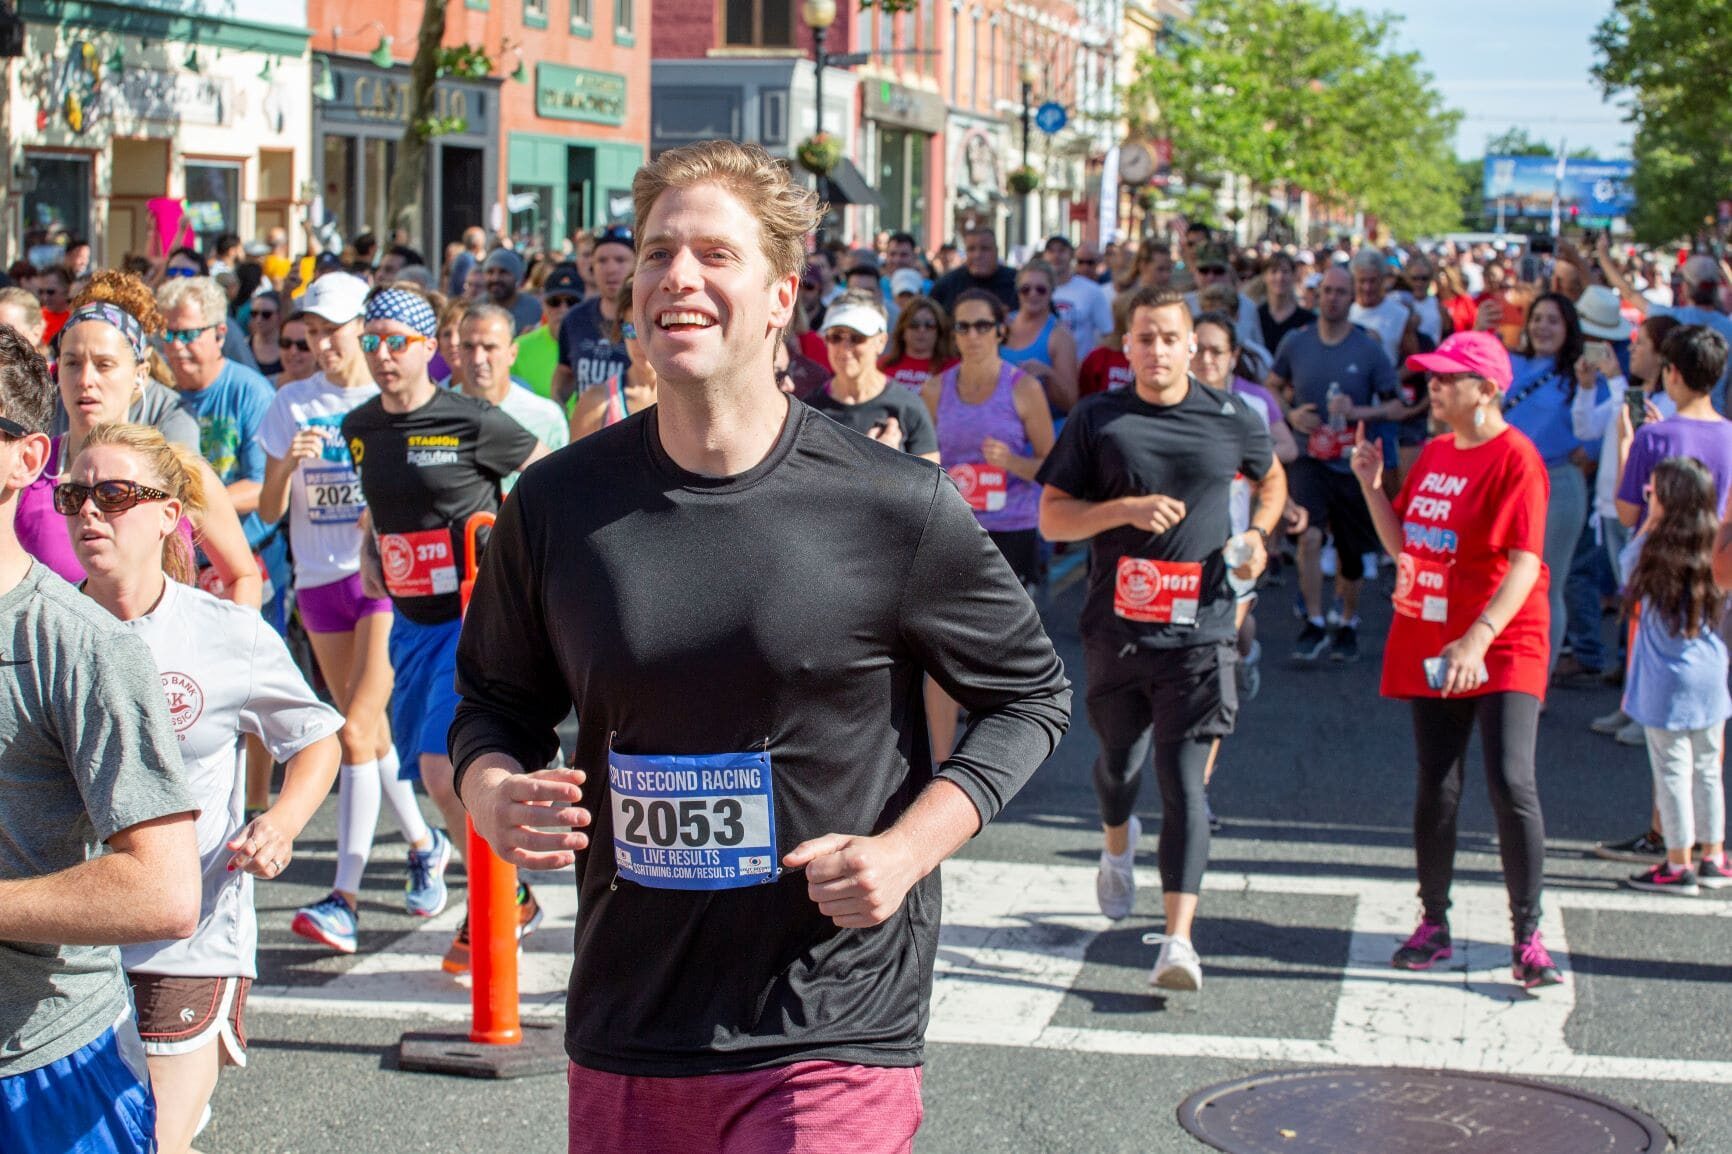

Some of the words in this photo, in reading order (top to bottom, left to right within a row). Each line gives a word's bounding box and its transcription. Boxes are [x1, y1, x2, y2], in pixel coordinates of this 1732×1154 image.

[577, 358, 624, 384] RUN
[407, 435, 459, 447] STADION
[406, 450, 458, 463] Rakuten
[1418, 472, 1468, 496] RUN
[1406, 495, 1452, 521] FOR
[416, 542, 447, 561] 379
[1162, 575, 1200, 591] 1017
[171, 676, 197, 697] BANK
[636, 770, 698, 792] SECOND
[702, 768, 761, 791] RACING
[621, 798, 745, 847] 2053
[643, 848, 666, 865] LIVE
[669, 849, 720, 866] RESULTS
[633, 862, 736, 879] SSRTIMING.COM/RESULTS
